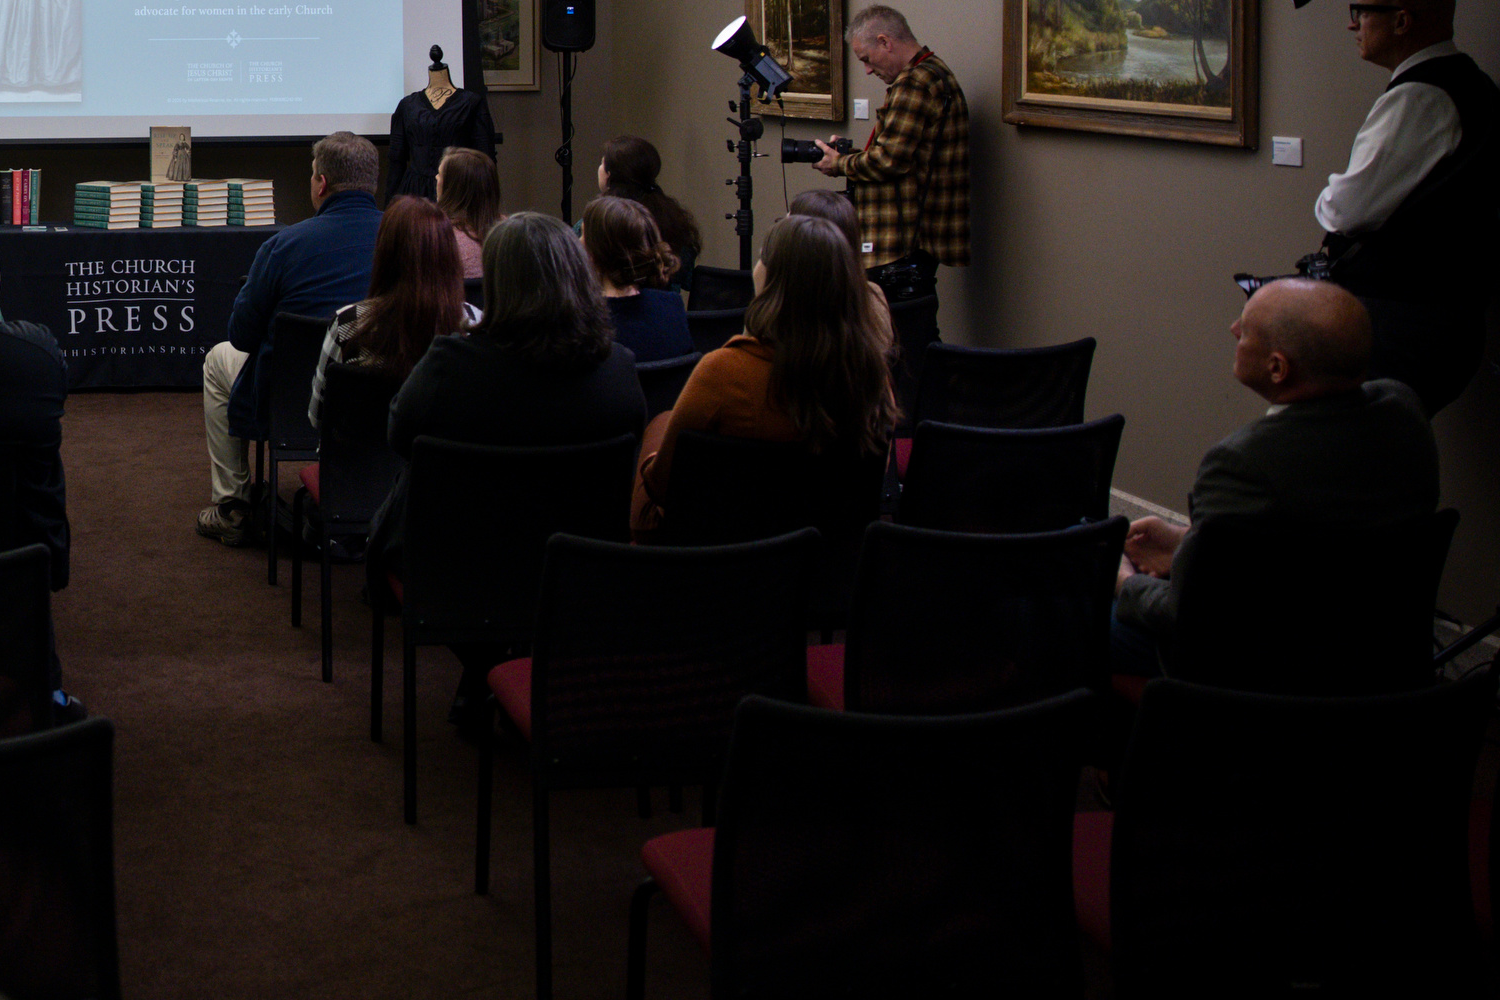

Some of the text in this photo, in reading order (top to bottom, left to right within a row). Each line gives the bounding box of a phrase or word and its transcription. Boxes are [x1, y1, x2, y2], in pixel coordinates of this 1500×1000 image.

[134, 5, 333, 18] advocate for women in the early Church
[187, 69, 233, 78] JESUS CHRIST
[249, 74, 283, 82] PRESS
[65, 260, 196, 276] THE CHURCH
[66, 280, 195, 296] HISTORIAN'S
[68, 305, 195, 334] PRESS
